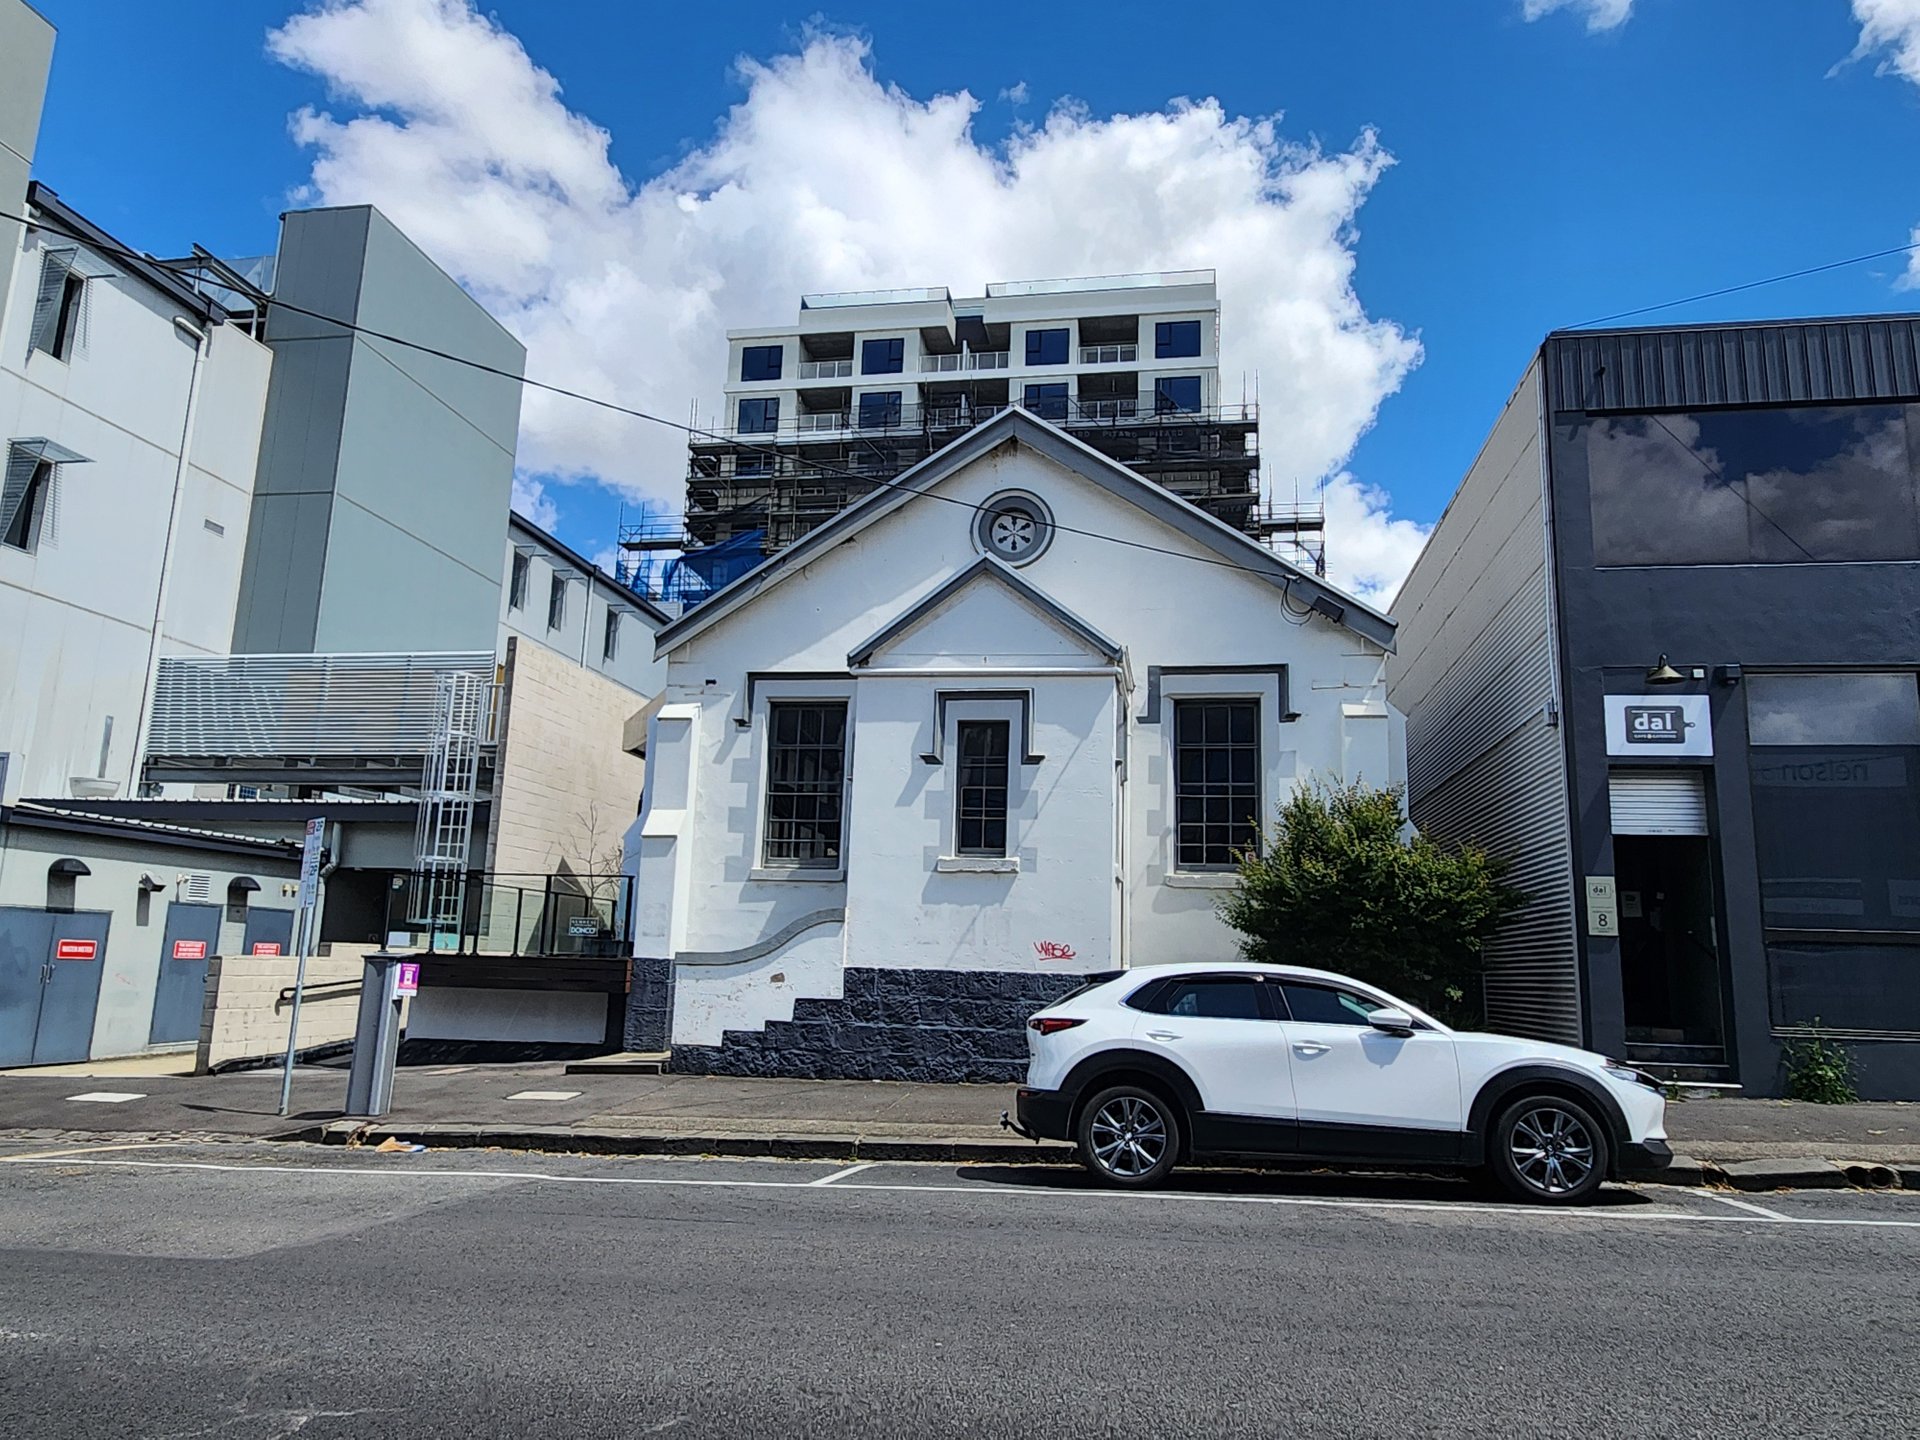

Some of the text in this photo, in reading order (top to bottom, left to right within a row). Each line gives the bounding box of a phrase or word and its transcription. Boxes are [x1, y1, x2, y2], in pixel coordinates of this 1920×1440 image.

[1102, 430, 1138, 438] PITARD
[1634, 712, 1672, 730] dal
[1598, 913, 1608, 927] 8
